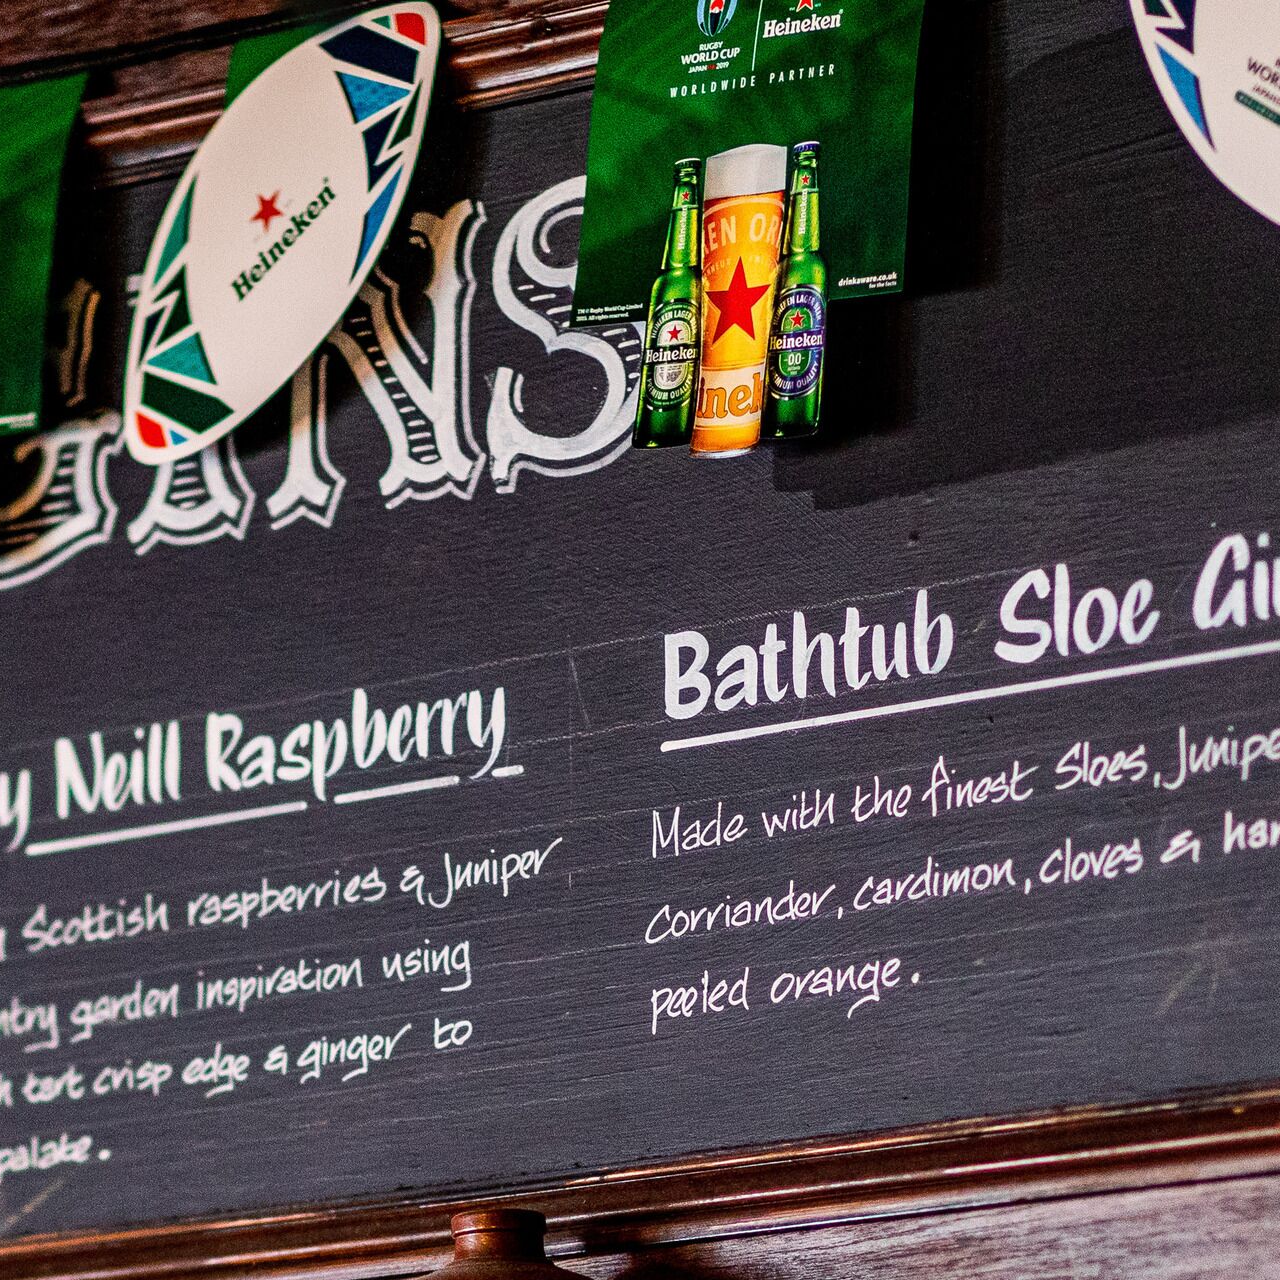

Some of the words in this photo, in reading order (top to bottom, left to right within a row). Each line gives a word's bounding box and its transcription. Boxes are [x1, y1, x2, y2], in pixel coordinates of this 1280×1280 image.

[681, 50, 719, 65] WORLD
[720, 47, 741, 59] CUP
[699, 41, 723, 51] RUGBY
[763, 13, 842, 38] Heineken
[670, 76, 756, 98] WORLDWIDE
[769, 64, 836, 84] PARTNER
[230, 183, 336, 301] Heineken
[838, 272, 897, 287] drinkaware.co.uk
[769, 332, 824, 350] Heineken
[664, 588, 955, 719] Bathtub
[995, 563, 1160, 664] Sloe
[54, 719, 180, 819] Neill
[205, 686, 507, 802] Raspberry
[651, 802, 749, 858] Made
[762, 788, 835, 837] with
[851, 776, 912, 822] the
[922, 755, 1040, 817] finest
[1160, 830, 1201, 864] &
[22, 893, 170, 952] Scottish
[187, 866, 387, 928] raspberries
[69, 979, 180, 1043] garden
[195, 957, 364, 1012] inspiration
[381, 938, 472, 993] using
[651, 966, 750, 1035] peeled
[93, 1058, 173, 1098] crisp
[181, 1042, 250, 1098] edge
[296, 1022, 412, 1083] ginger
[433, 1017, 473, 1050] to
